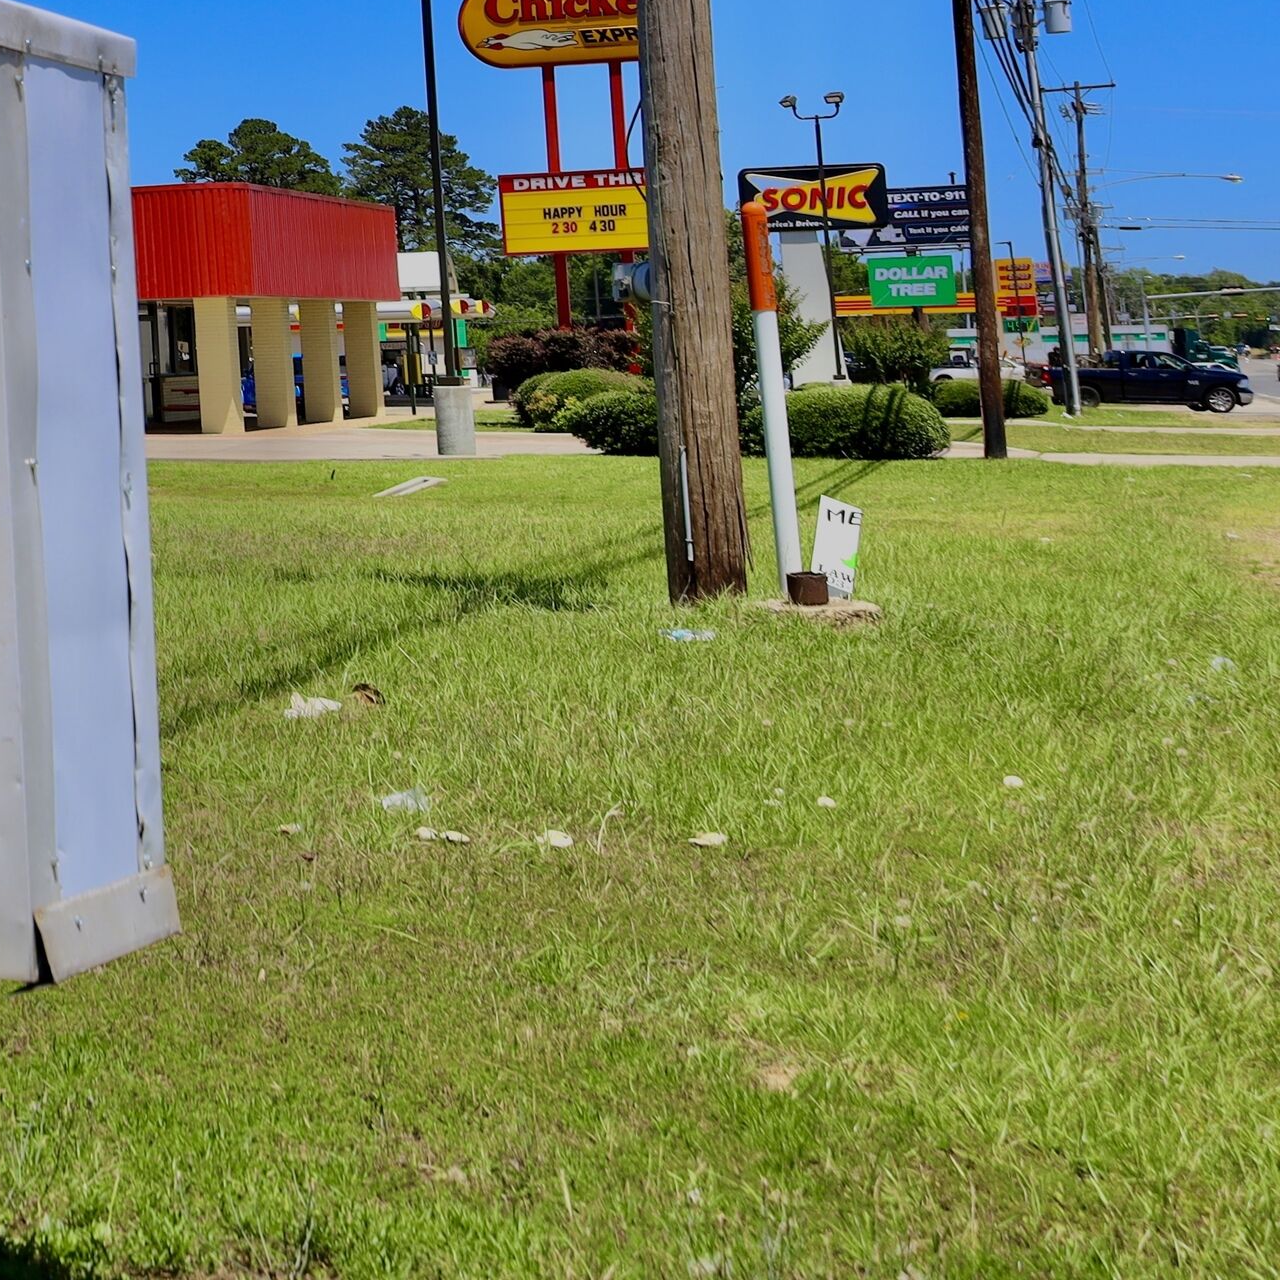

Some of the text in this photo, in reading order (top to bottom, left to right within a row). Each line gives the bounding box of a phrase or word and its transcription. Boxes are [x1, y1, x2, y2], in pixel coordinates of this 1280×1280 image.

[513, 175, 586, 191] DRIVE
[762, 184, 869, 212] SONIC
[887, 190, 966, 203] TEXT-TO-911
[543, 204, 626, 219] HAPPY HOUR
[894, 211, 920, 219] CALL
[930, 210, 950, 219] you
[874, 266, 948, 281] DOLLAR
[888, 282, 937, 297] TREE
